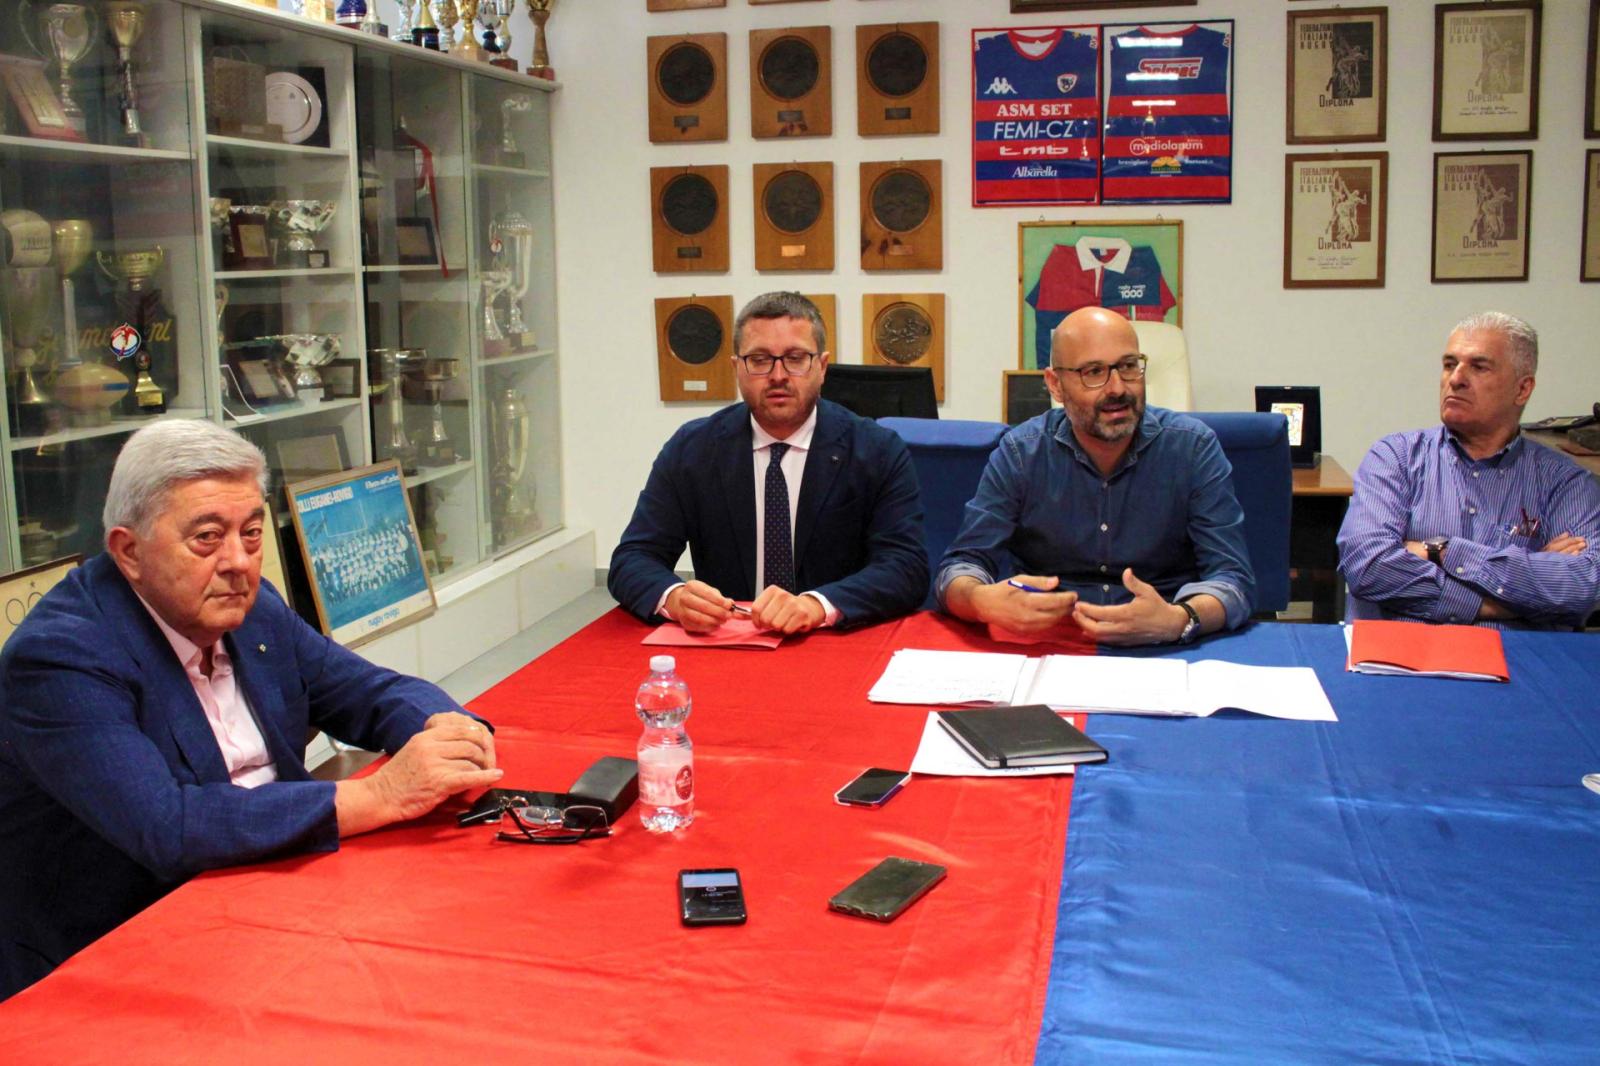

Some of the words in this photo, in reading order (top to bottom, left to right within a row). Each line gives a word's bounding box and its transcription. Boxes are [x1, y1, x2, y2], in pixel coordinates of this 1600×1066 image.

[996, 103, 1035, 117] ASM
[1041, 103, 1072, 117] SET
[993, 120, 1074, 140] FEMI-CZ
[999, 144, 1069, 156] tmb
[1130, 138, 1203, 154] mediolanum
[1012, 165, 1058, 178] Albarella
[1120, 289, 1143, 299] 1000
